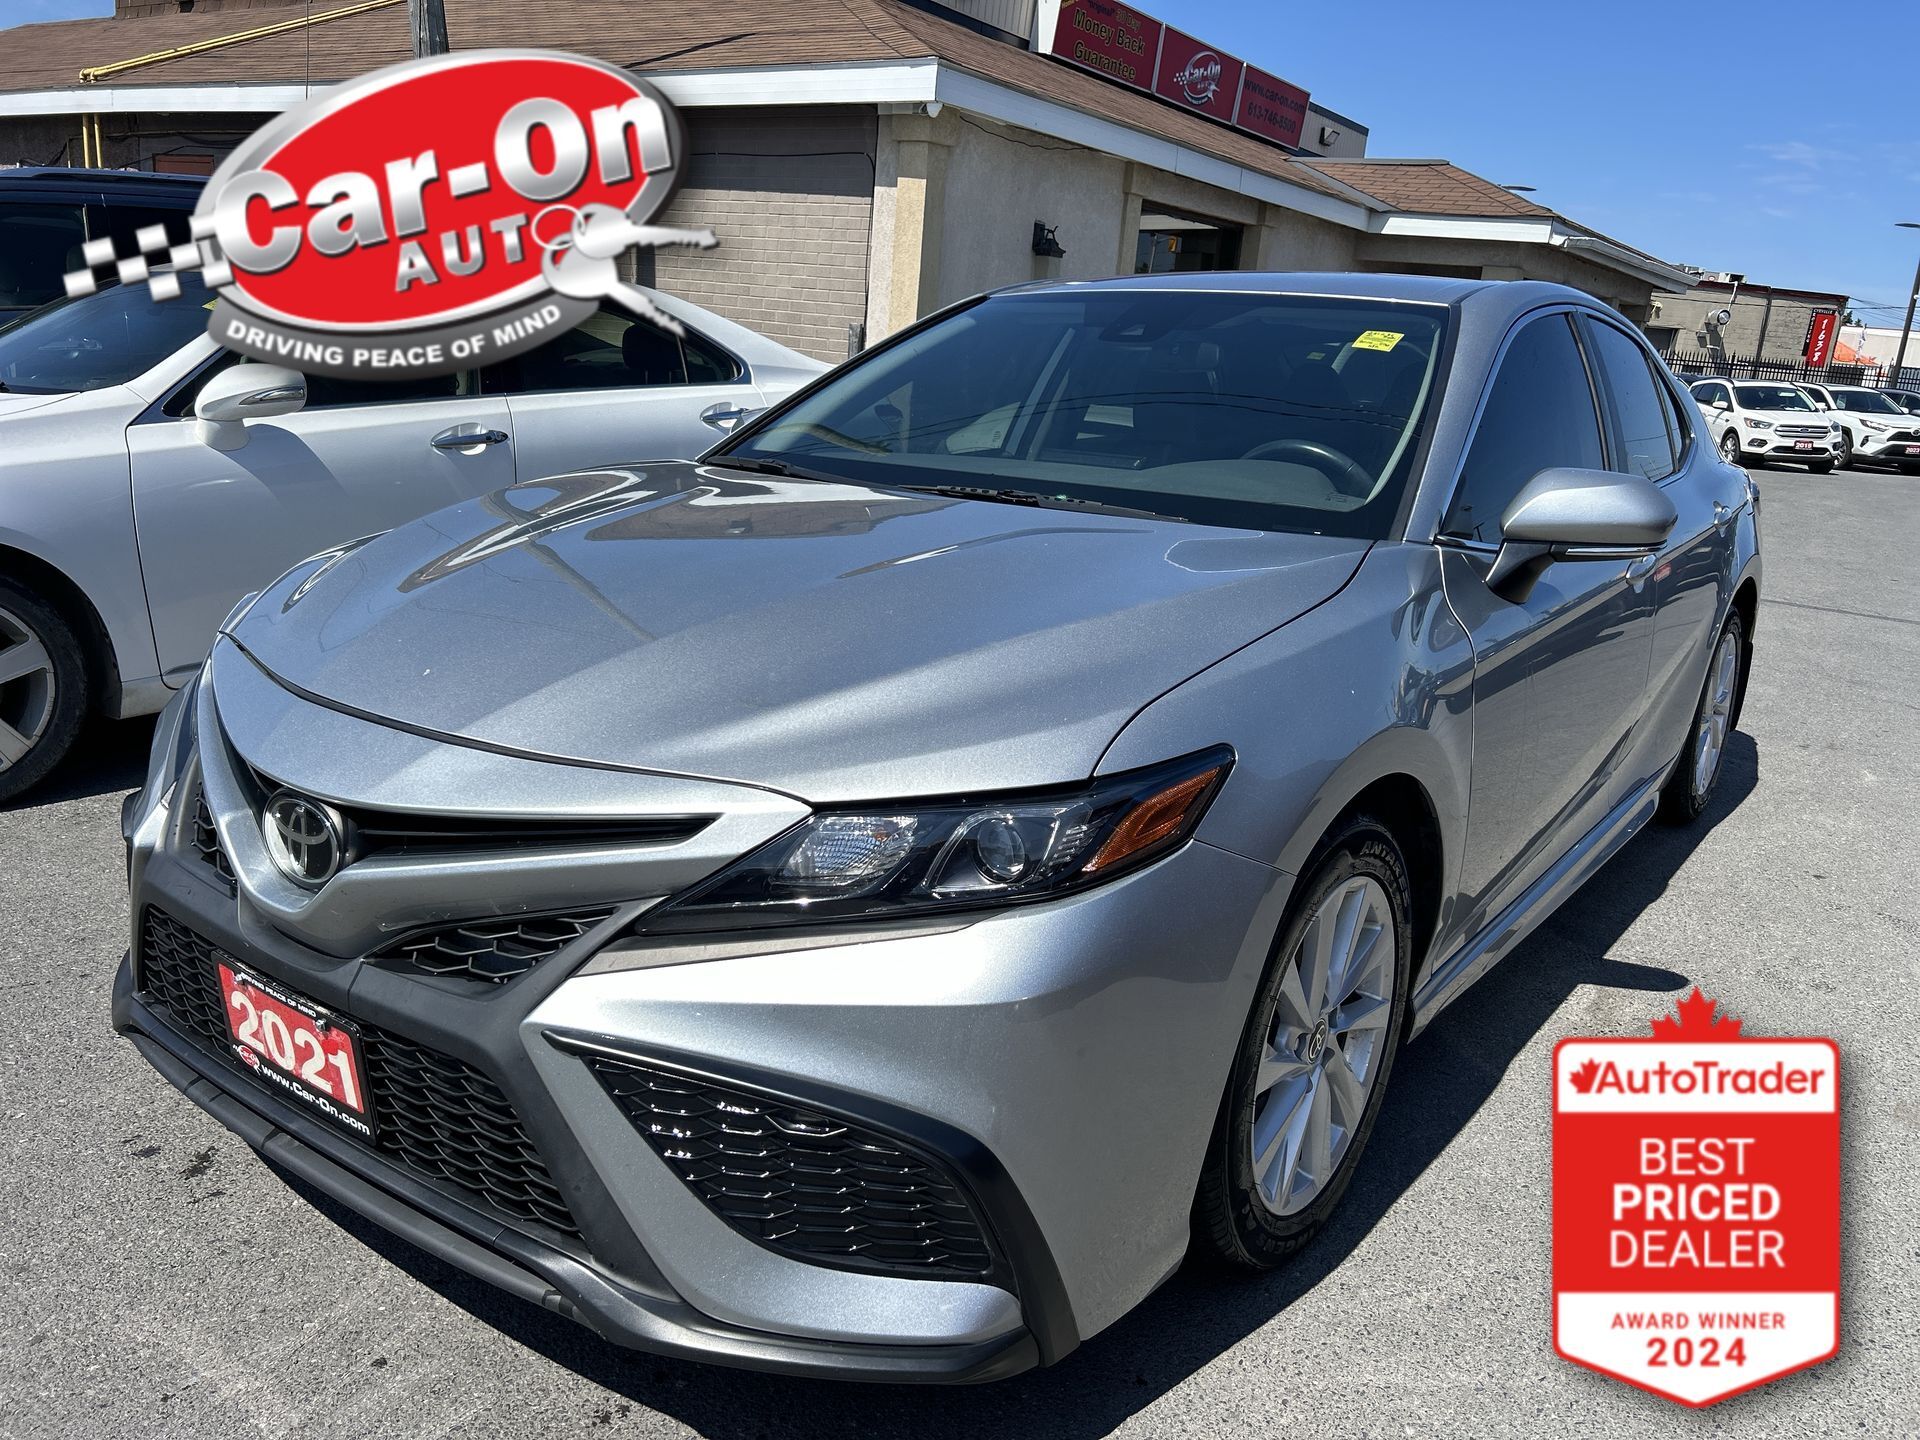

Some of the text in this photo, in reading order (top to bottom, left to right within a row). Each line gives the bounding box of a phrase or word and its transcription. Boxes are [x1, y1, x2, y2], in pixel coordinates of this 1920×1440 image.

[1073, 8, 1146, 56] Money Back
[1073, 40, 1136, 81] Guarantee
[231, 990, 359, 1111] 2021
[260, 1063, 371, 1136] www.Car-On.com
